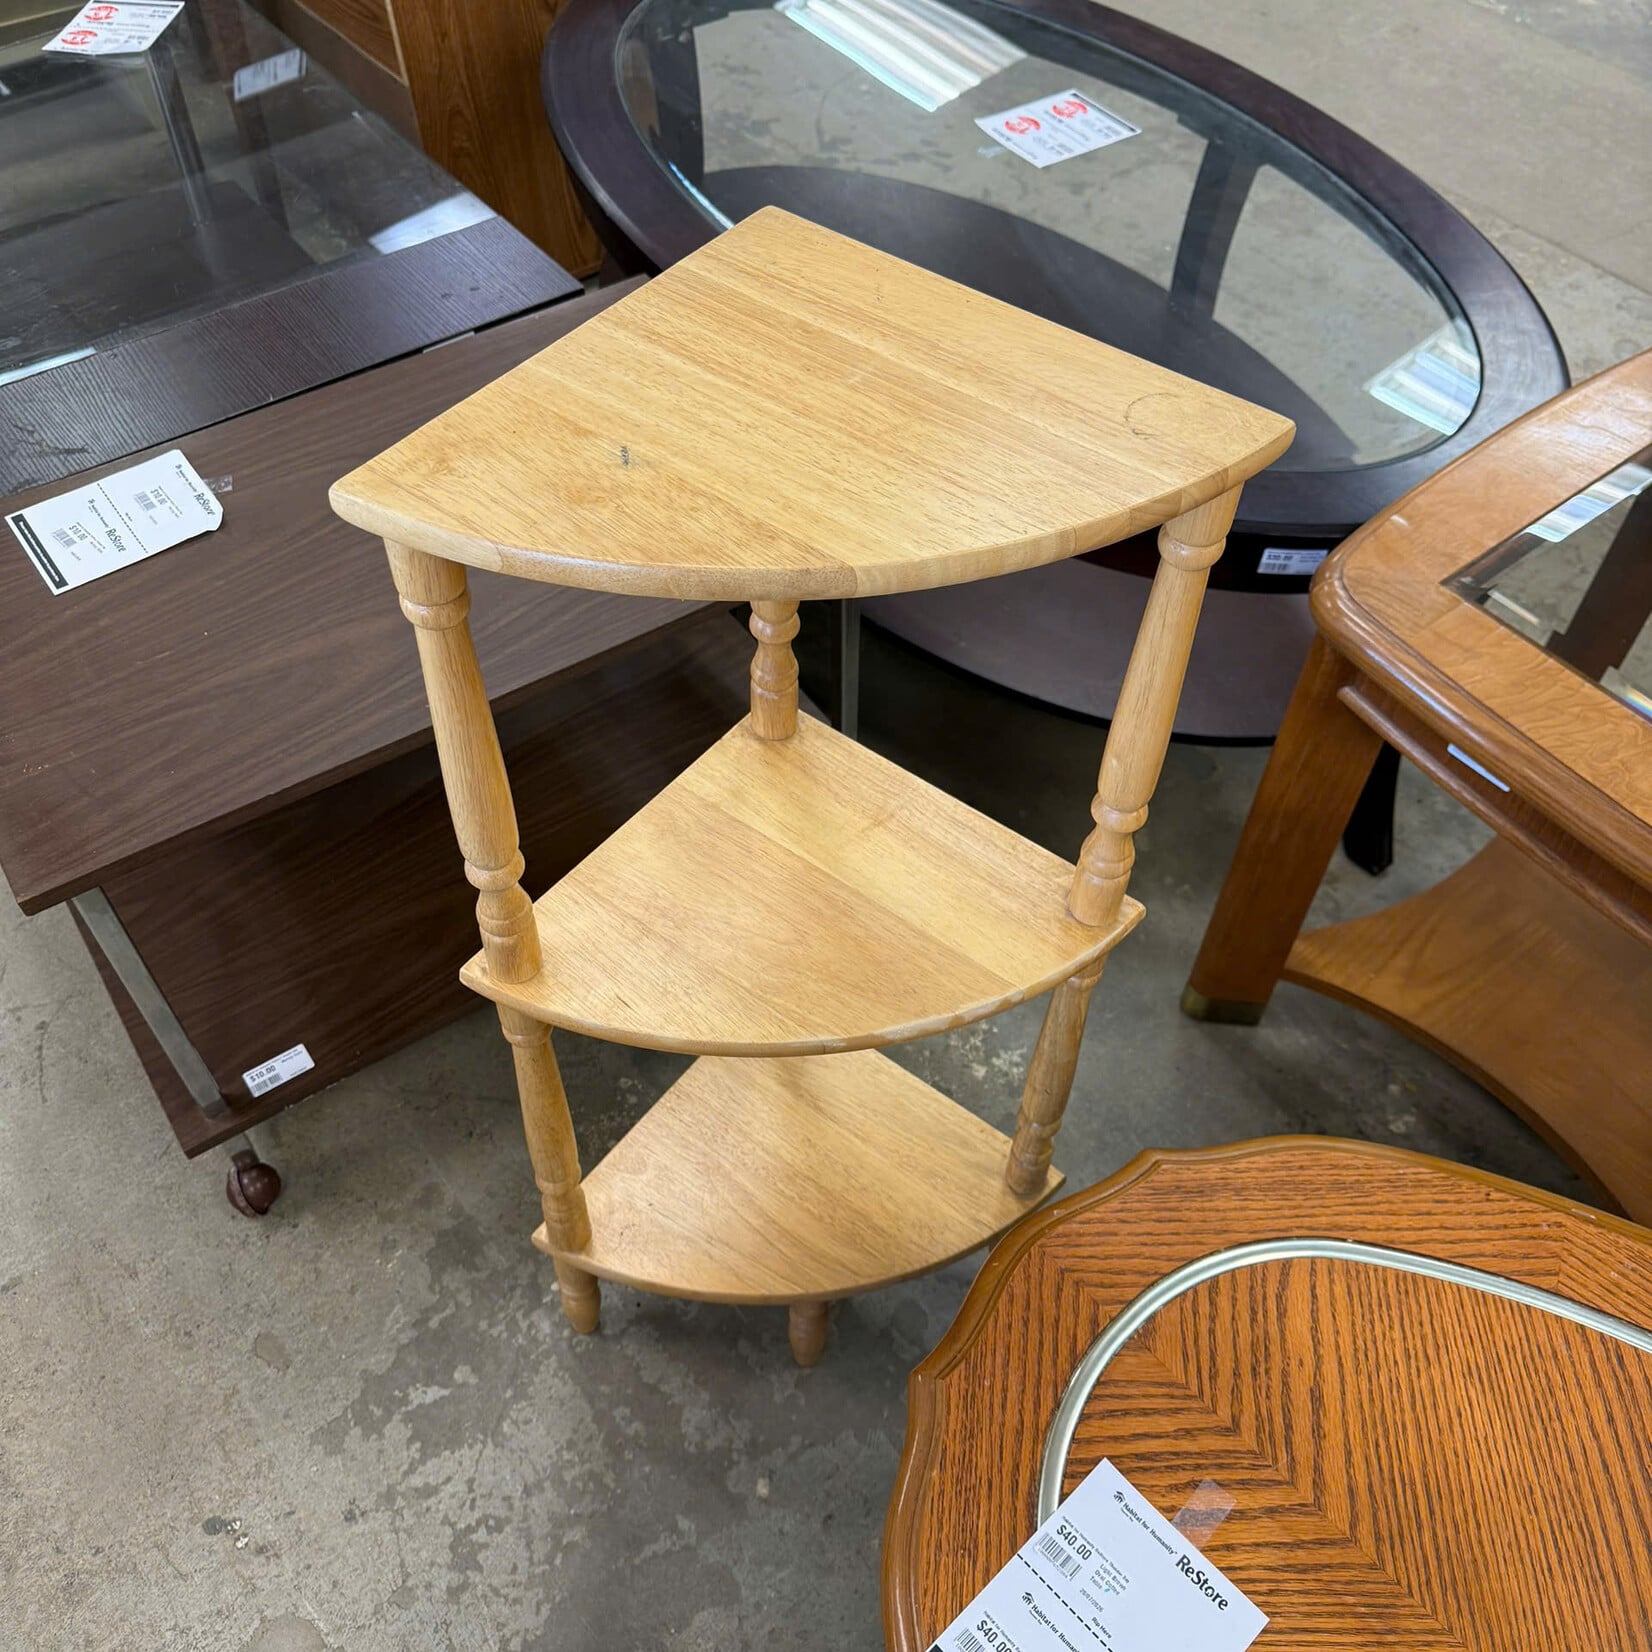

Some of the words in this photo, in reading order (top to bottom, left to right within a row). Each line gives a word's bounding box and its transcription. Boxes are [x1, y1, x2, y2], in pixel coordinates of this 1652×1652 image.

[194, 492, 216, 516] ReStore
[105, 528, 127, 552] ReStore
[250, 1064, 277, 1082] $10.00
[1056, 1524, 1092, 1561] $40.00
[1123, 1502, 1143, 1523] Habitat
[1141, 1520, 1150, 1530] for
[1150, 1528, 1174, 1555] Humanity
[1175, 1553, 1229, 1611] ReStore
[1090, 1575, 1102, 1590] Table
[1095, 1569, 1106, 1582] Oval
[1105, 1580, 1120, 1595] Coffee
[1100, 1563, 1113, 1577] Light
[1112, 1575, 1127, 1591] Brown
[1031, 1604, 1051, 1626] Habitat
[1050, 1624, 1059, 1634] for
[1092, 1616, 1101, 1628] Rip
[1100, 1625, 1112, 1639] Here
